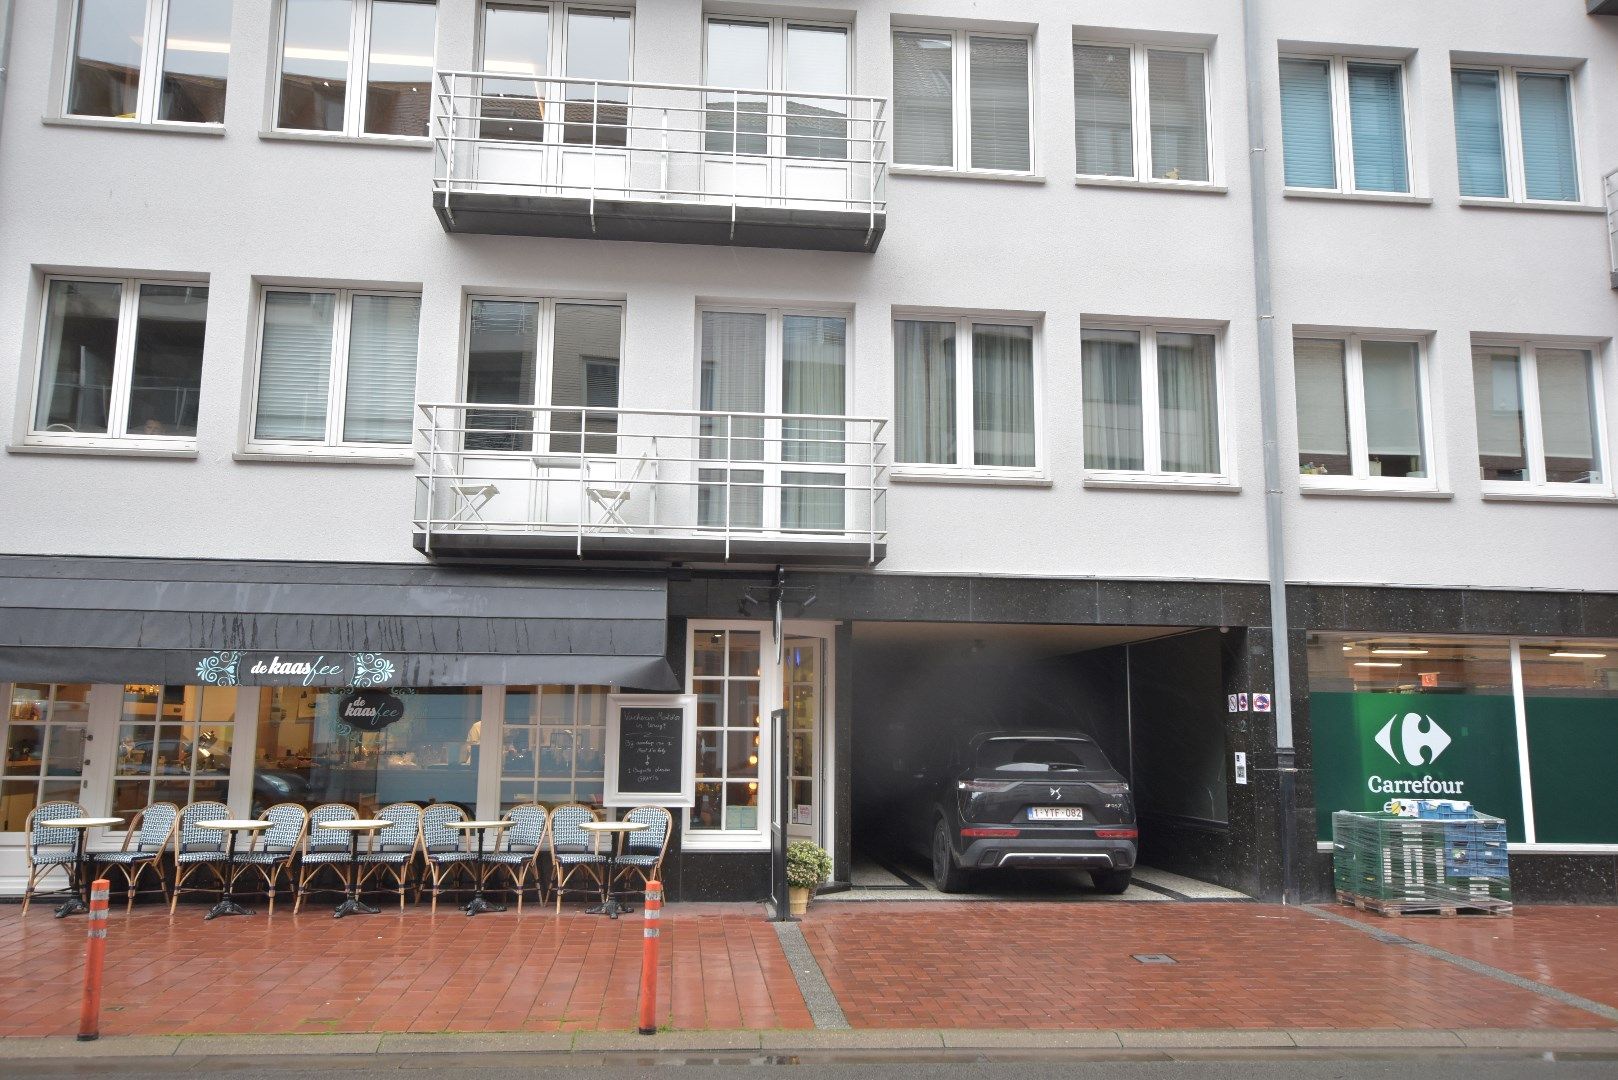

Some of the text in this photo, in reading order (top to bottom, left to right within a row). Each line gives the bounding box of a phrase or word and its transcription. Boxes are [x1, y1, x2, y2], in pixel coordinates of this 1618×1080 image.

[251, 661, 268, 674] de
[353, 697, 366, 707] de
[1368, 775, 1464, 794] Carrefour
